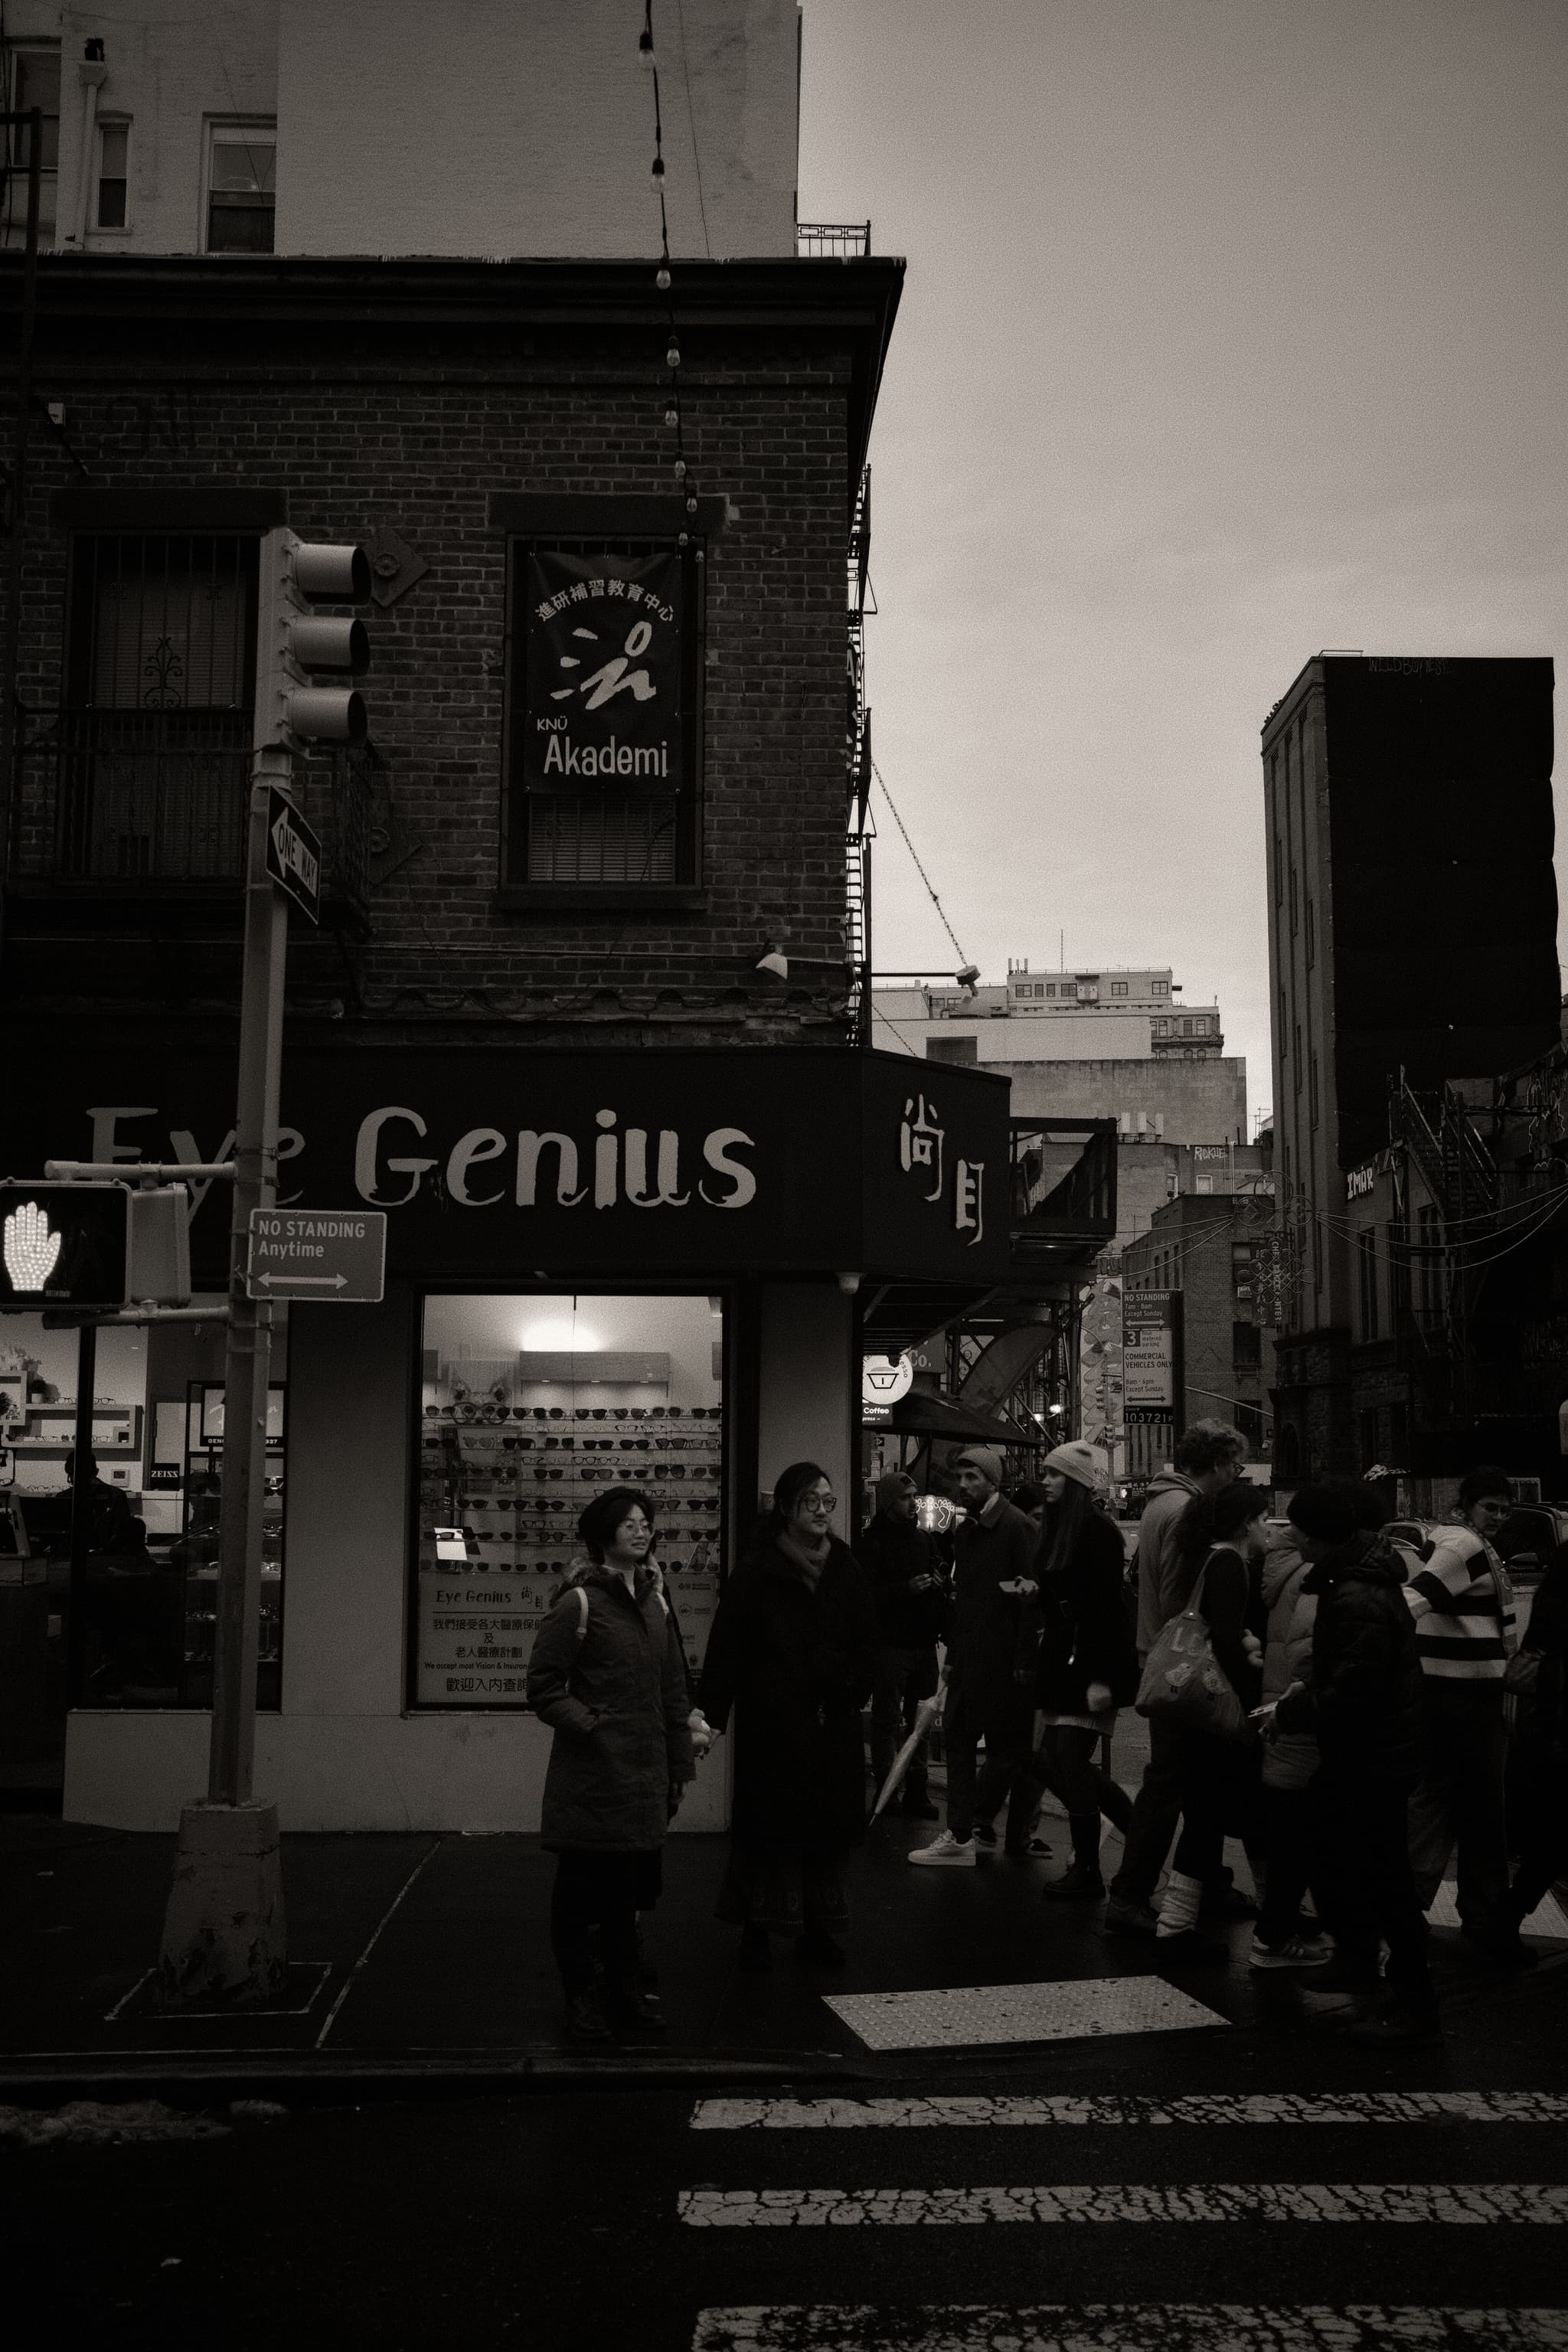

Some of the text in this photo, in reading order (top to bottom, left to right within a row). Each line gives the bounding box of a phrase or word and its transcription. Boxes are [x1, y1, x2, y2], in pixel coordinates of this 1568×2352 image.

[535, 579, 675, 622] 進研補習教育中心
[537, 716, 568, 731] KNÜ
[544, 734, 668, 778] Akademi
[279, 823, 318, 891] ONE WAY
[354, 1106, 756, 1210] Genius
[259, 1220, 366, 1239] NO STANDING
[259, 1240, 325, 1258] Anytime
[1135, 1293, 1171, 1302] STANDING
[1127, 1331, 1137, 1346] 3
[436, 1590, 511, 1605] Eye Genius
[483, 1632, 494, 1644] 及
